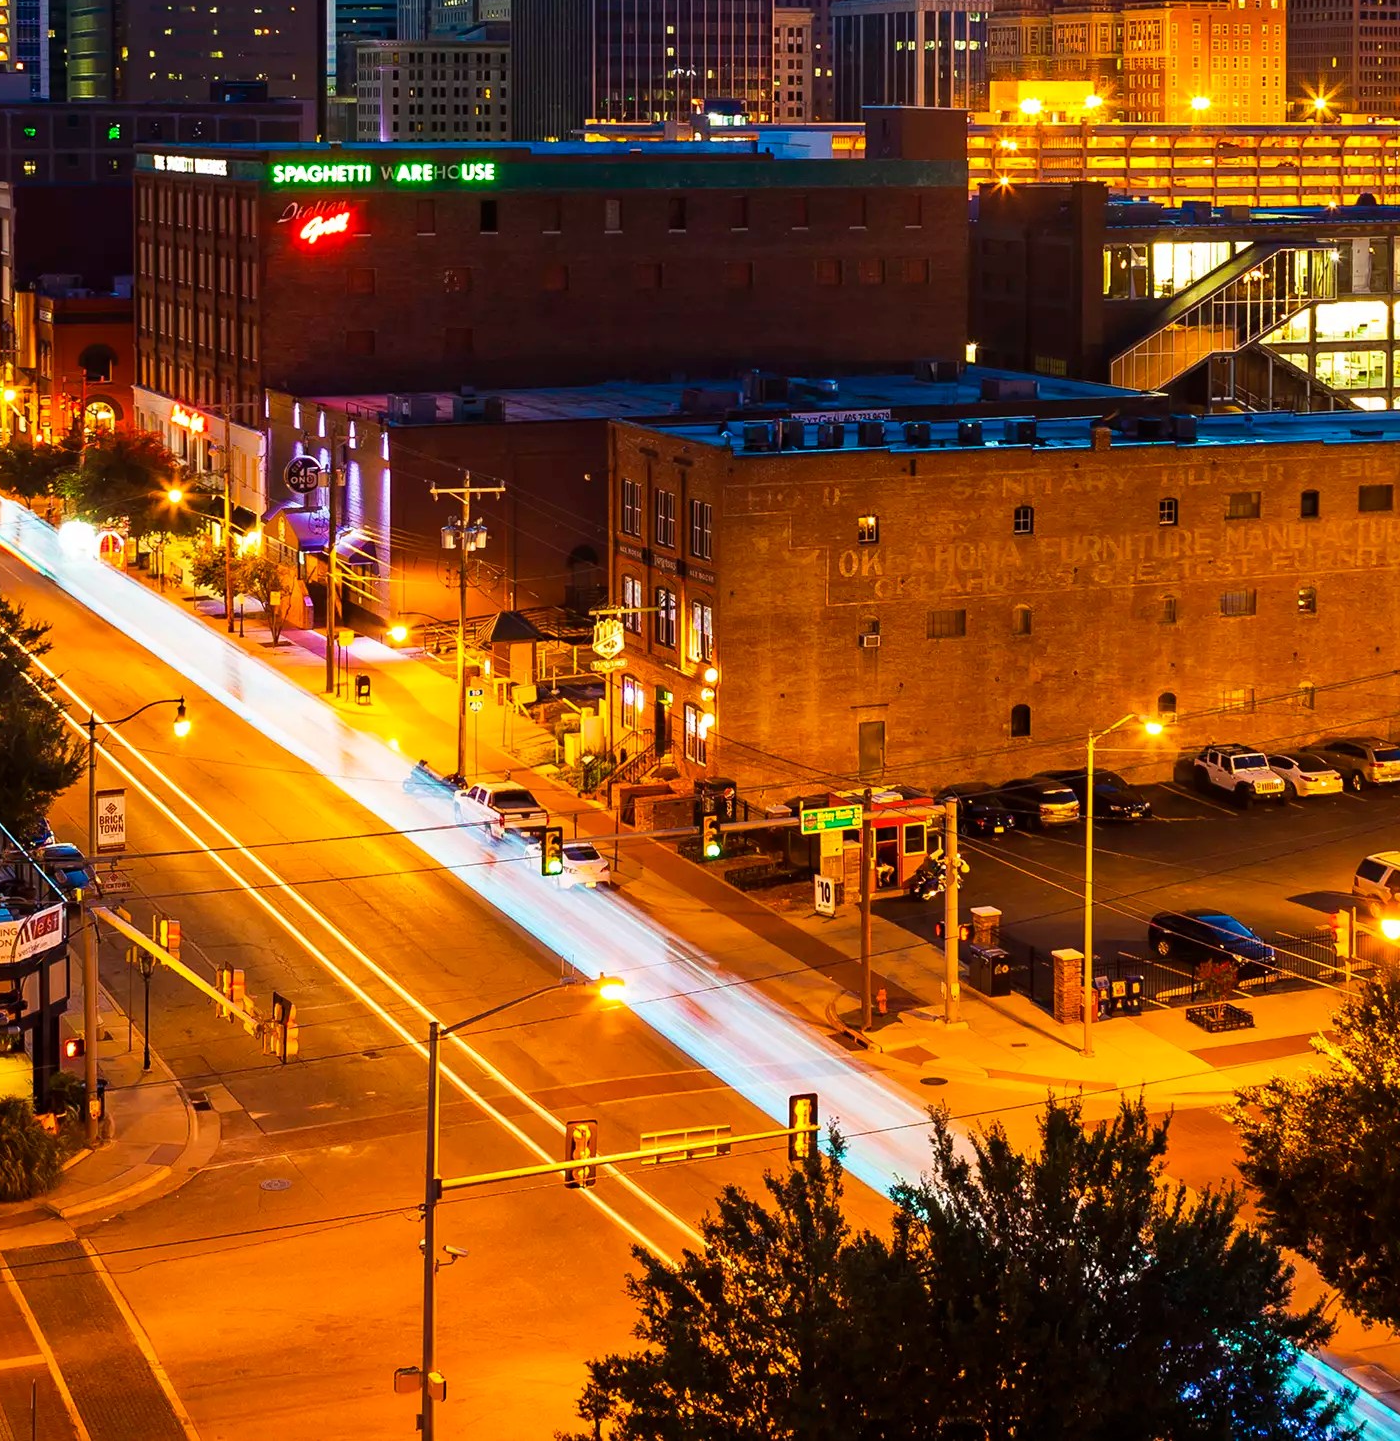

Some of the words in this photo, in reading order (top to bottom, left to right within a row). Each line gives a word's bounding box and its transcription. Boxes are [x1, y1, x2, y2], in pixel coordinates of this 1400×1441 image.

[273, 164, 372, 183] SPAGHETTI
[380, 163, 496, 182] WAREHOUSE
[99, 814, 124, 824] BRICK
[100, 824, 124, 835] TOWN
